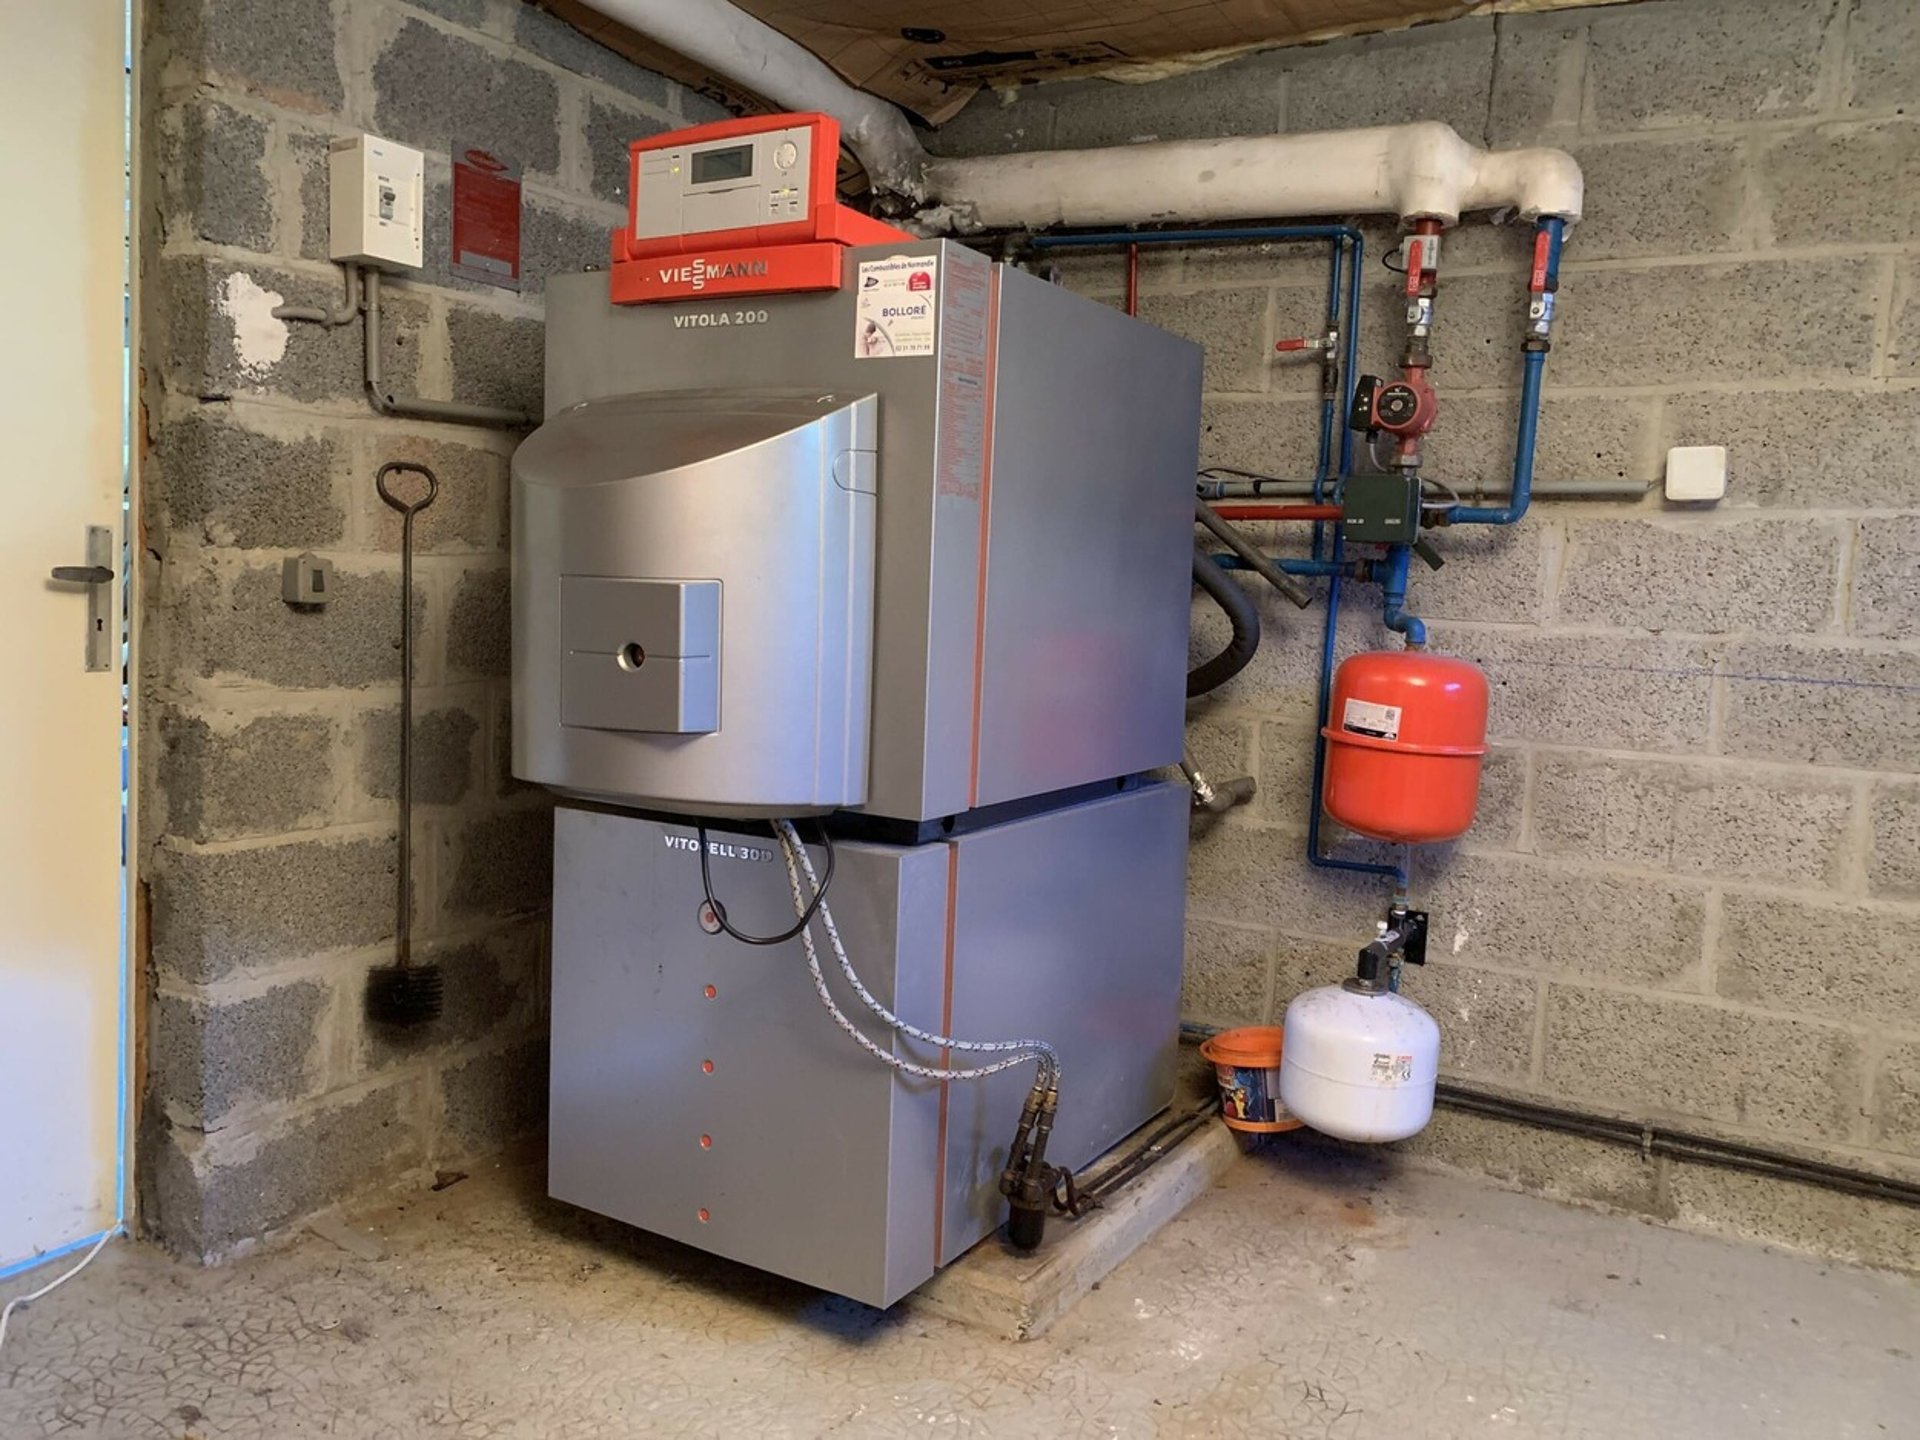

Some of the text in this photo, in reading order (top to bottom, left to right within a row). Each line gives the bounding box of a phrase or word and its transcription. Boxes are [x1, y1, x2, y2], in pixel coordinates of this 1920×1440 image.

[659, 258, 768, 290] VIESSMANN
[673, 310, 768, 328] VITOLA 200
[882, 305, 926, 317] BOLLORÉ
[664, 836, 736, 858] VITOELL
